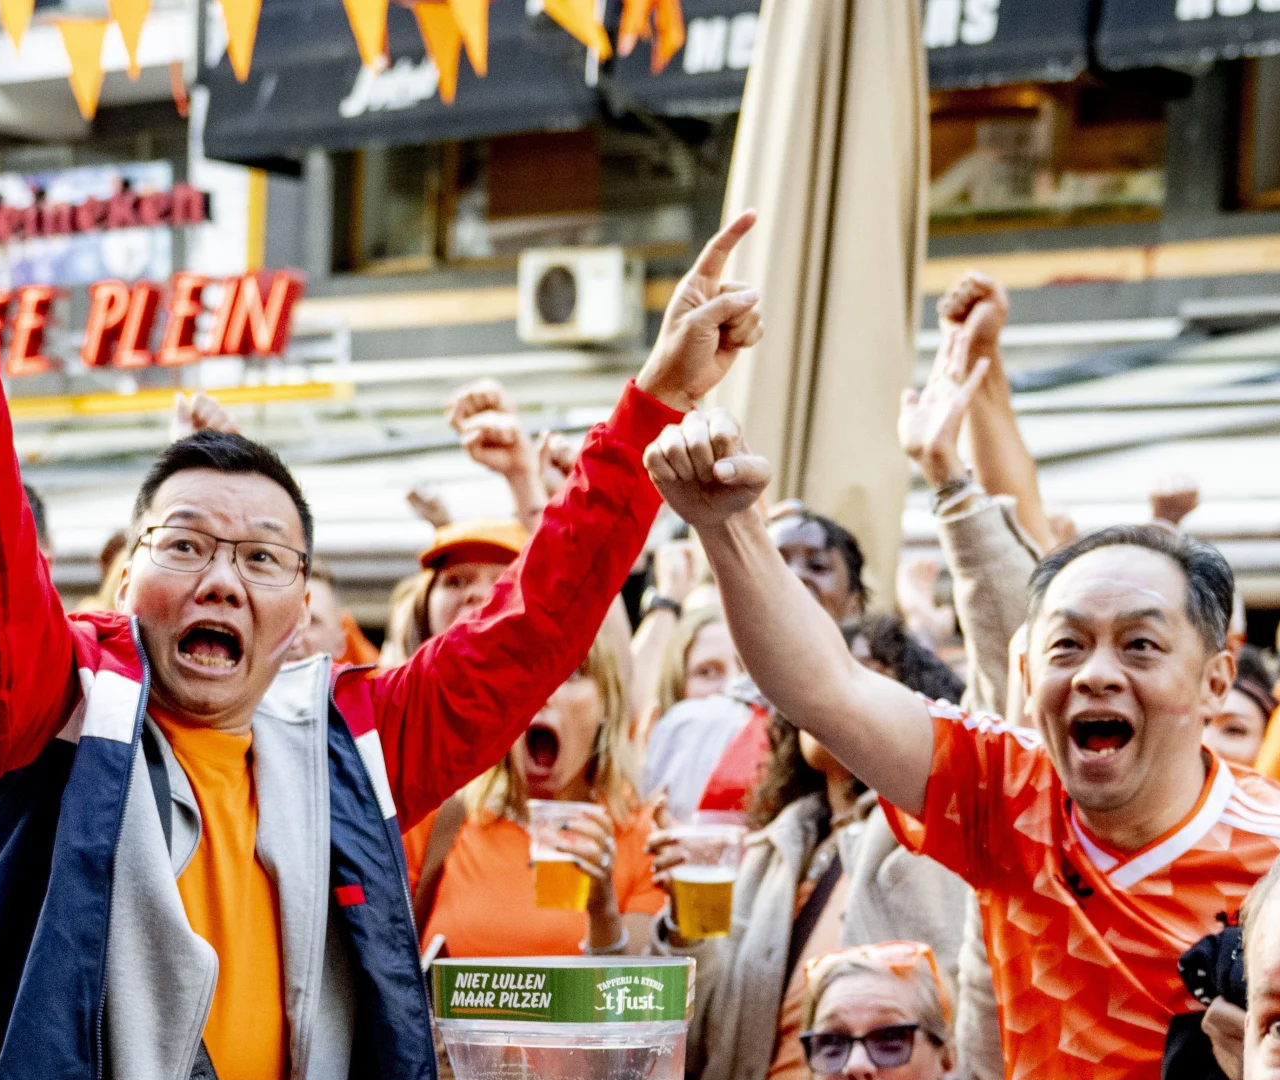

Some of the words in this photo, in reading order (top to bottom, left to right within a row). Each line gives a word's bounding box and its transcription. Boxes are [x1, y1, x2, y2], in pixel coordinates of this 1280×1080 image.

[80, 268, 304, 370] PLEIN
[455, 972, 490, 989] NIET
[491, 973, 546, 990] LULLEN
[596, 976, 632, 992] TAPPERIJ
[633, 975, 640, 985] &
[450, 990, 496, 1007] MAAR
[498, 991, 552, 1009] PILZEN
